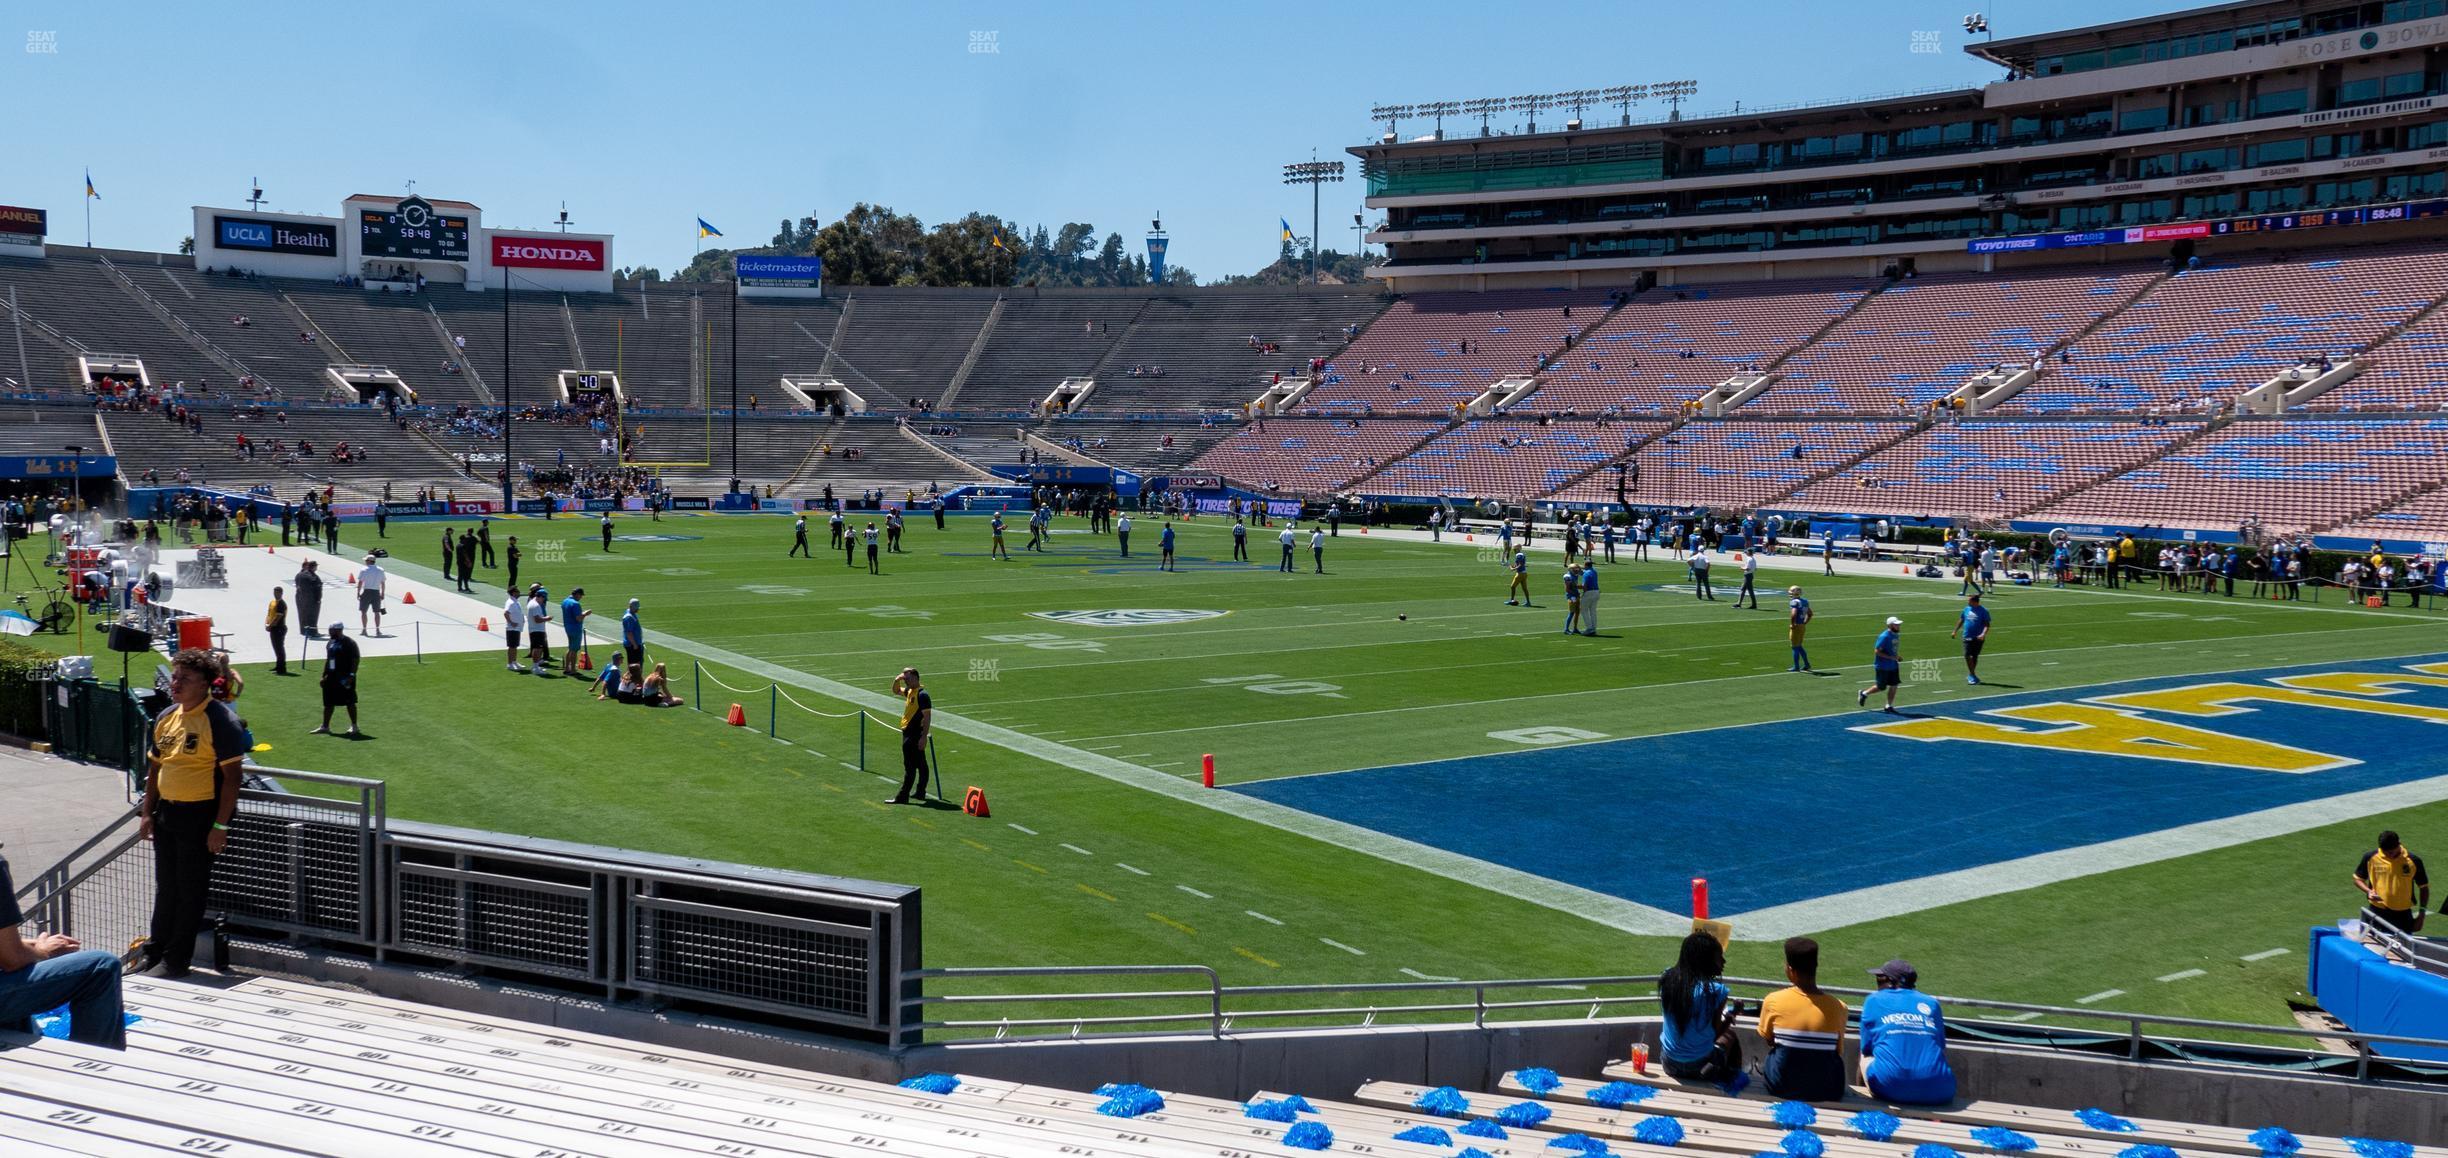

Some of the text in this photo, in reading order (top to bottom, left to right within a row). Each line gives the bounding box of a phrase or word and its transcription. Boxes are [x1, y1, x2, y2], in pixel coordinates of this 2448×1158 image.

[2297, 23, 2445, 58] ROSE BOWL
[2304, 112, 2332, 123] TERRY
[2385, 99, 2432, 112] PAVILION
[390, 216, 396, 224] 0
[440, 219, 447, 227] 0
[2219, 223, 2227, 233] 0
[2283, 217, 2291, 227] 0
[2372, 208, 2402, 220] 58:48
[364, 226, 369, 234] 3
[401, 229, 431, 239] 58:48
[228, 228, 330, 248] UCLA Health
[462, 232, 467, 240] 3
[2064, 233, 2105, 243] ONTARIO
[1975, 239, 2037, 251] TOYO TIRES
[501, 246, 596, 261] HONDA
[740, 262, 815, 273] ticketmaster
[580, 375, 598, 388] 40
[1170, 478, 1219, 487] HONDA
[386, 506, 426, 514] NISSAN
[456, 504, 487, 514] TCL
[1268, 501, 1301, 515] TIRES
[868, 533, 878, 541] 59
[980, 632, 1106, 652] 20
[1202, 673, 1350, 698] 10
[1486, 725, 1611, 744] G
[967, 790, 979, 814] G
[1881, 1012, 1924, 1024] WESCOM
[179, 1046, 216, 1056] 109
[357, 1050, 392, 1061] 109
[72, 1061, 113, 1072] 110
[274, 1064, 311, 1075] 110
[444, 1067, 480, 1076] 110
[587, 1063, 619, 1073] 110
[727, 1069, 756, 1079] 110
[176, 1081, 220, 1093] 111
[371, 1082, 410, 1093] 111
[669, 1080, 702, 1089] 111
[816, 1084, 846, 1093] 111
[964, 1086, 985, 1094] 22
[763, 1096, 797, 1106] 112
[912, 1100, 945, 1110] 112
[1051, 1099, 1072, 1108] 21
[292, 1103, 337, 1116] 112
[477, 1104, 518, 1116] 112
[48, 1110, 99, 1125] 112
[742, 1116, 777, 1128] 113
[1015, 1116, 1048, 1127] 113
[1145, 1115, 1169, 1123] 20
[411, 1124, 456, 1139] 113
[599, 1122, 639, 1135] 113
[947, 1128, 980, 1138] 114
[1251, 1128, 1273, 1137] 19
[852, 1136, 889, 1148] 114
[1115, 1133, 1151, 1144] 114
[179, 1137, 232, 1153] 113
[714, 1143, 757, 1156] 114
[1353, 1145, 1375, 1153] 18
[2063, 1142, 2083, 1150] 10
[1058, 1146, 1096, 1157] 115
[1491, 1148, 1513, 1156] 17
